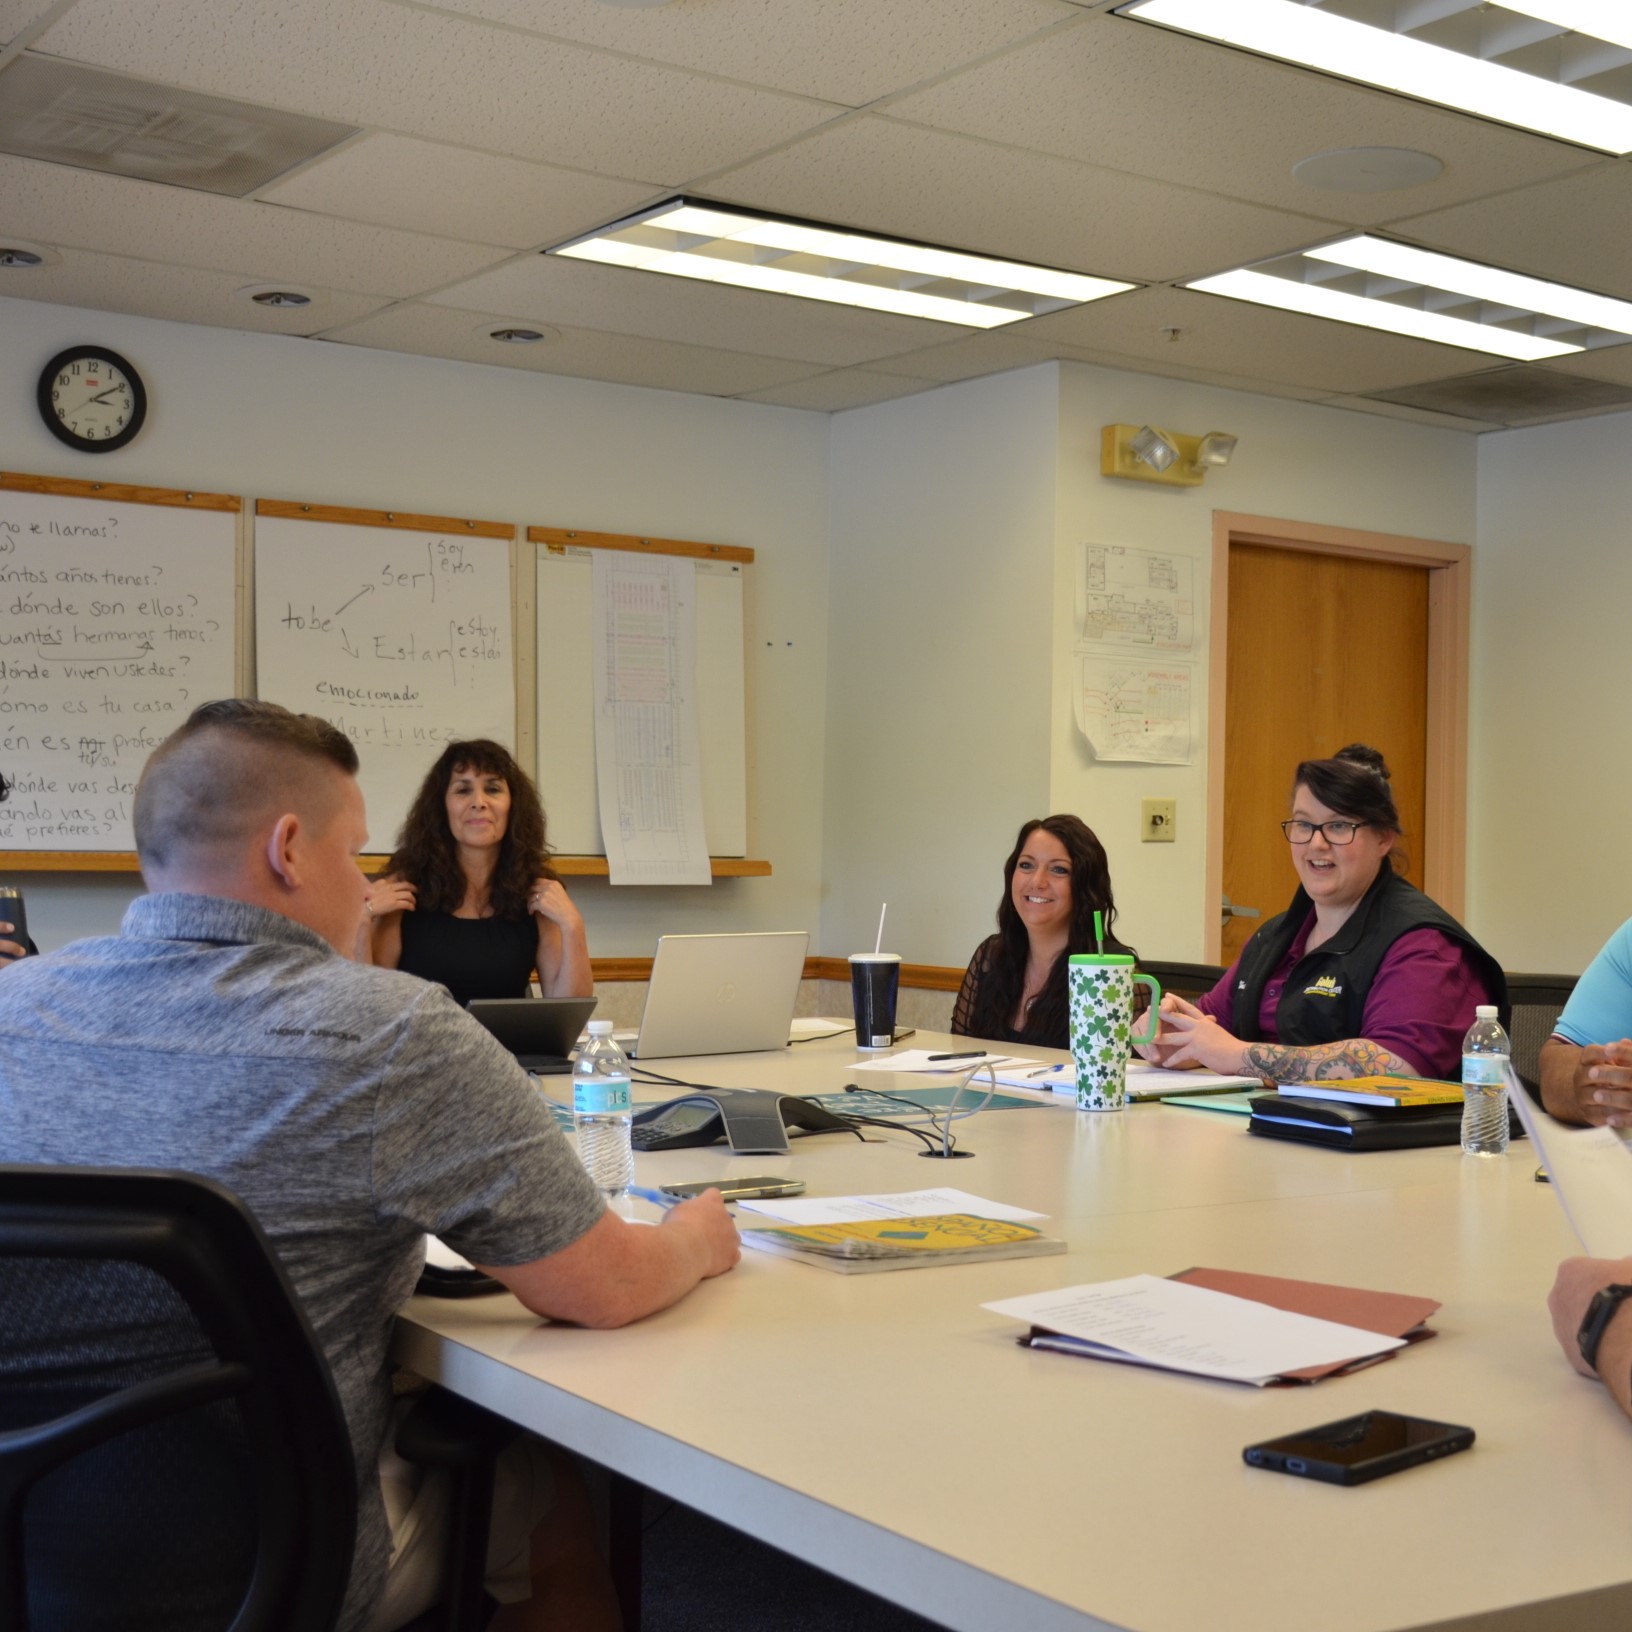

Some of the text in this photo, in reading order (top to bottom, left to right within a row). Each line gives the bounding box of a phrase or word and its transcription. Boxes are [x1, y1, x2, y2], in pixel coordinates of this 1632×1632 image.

[71, 364, 80, 375] 11
[88, 361, 98, 373] 12
[108, 368, 112, 380] 1
[59, 376, 70, 386] 10
[52, 391, 59, 401] 9
[123, 400, 130, 410] 3
[58, 408, 65, 419] 8
[116, 415, 123, 426] 4
[72, 421, 78, 433] 7
[104, 426, 112, 437] 5
[87, 428, 94, 439] 6
[49, 518, 118, 538] llamas?
[10, 592, 198, 618] dónde son ellos?
[64, 664, 110, 680] viven
[316, 680, 420, 701] emocionado
[62, 700, 88, 713] es
[100, 695, 122, 713] tu
[133, 689, 189, 712] casa?
[41, 735, 71, 750] es
[68, 780, 99, 793] vas
[60, 807, 97, 821] vas
[105, 802, 127, 821] al
[309, 1029, 361, 1043] ARMOUR
